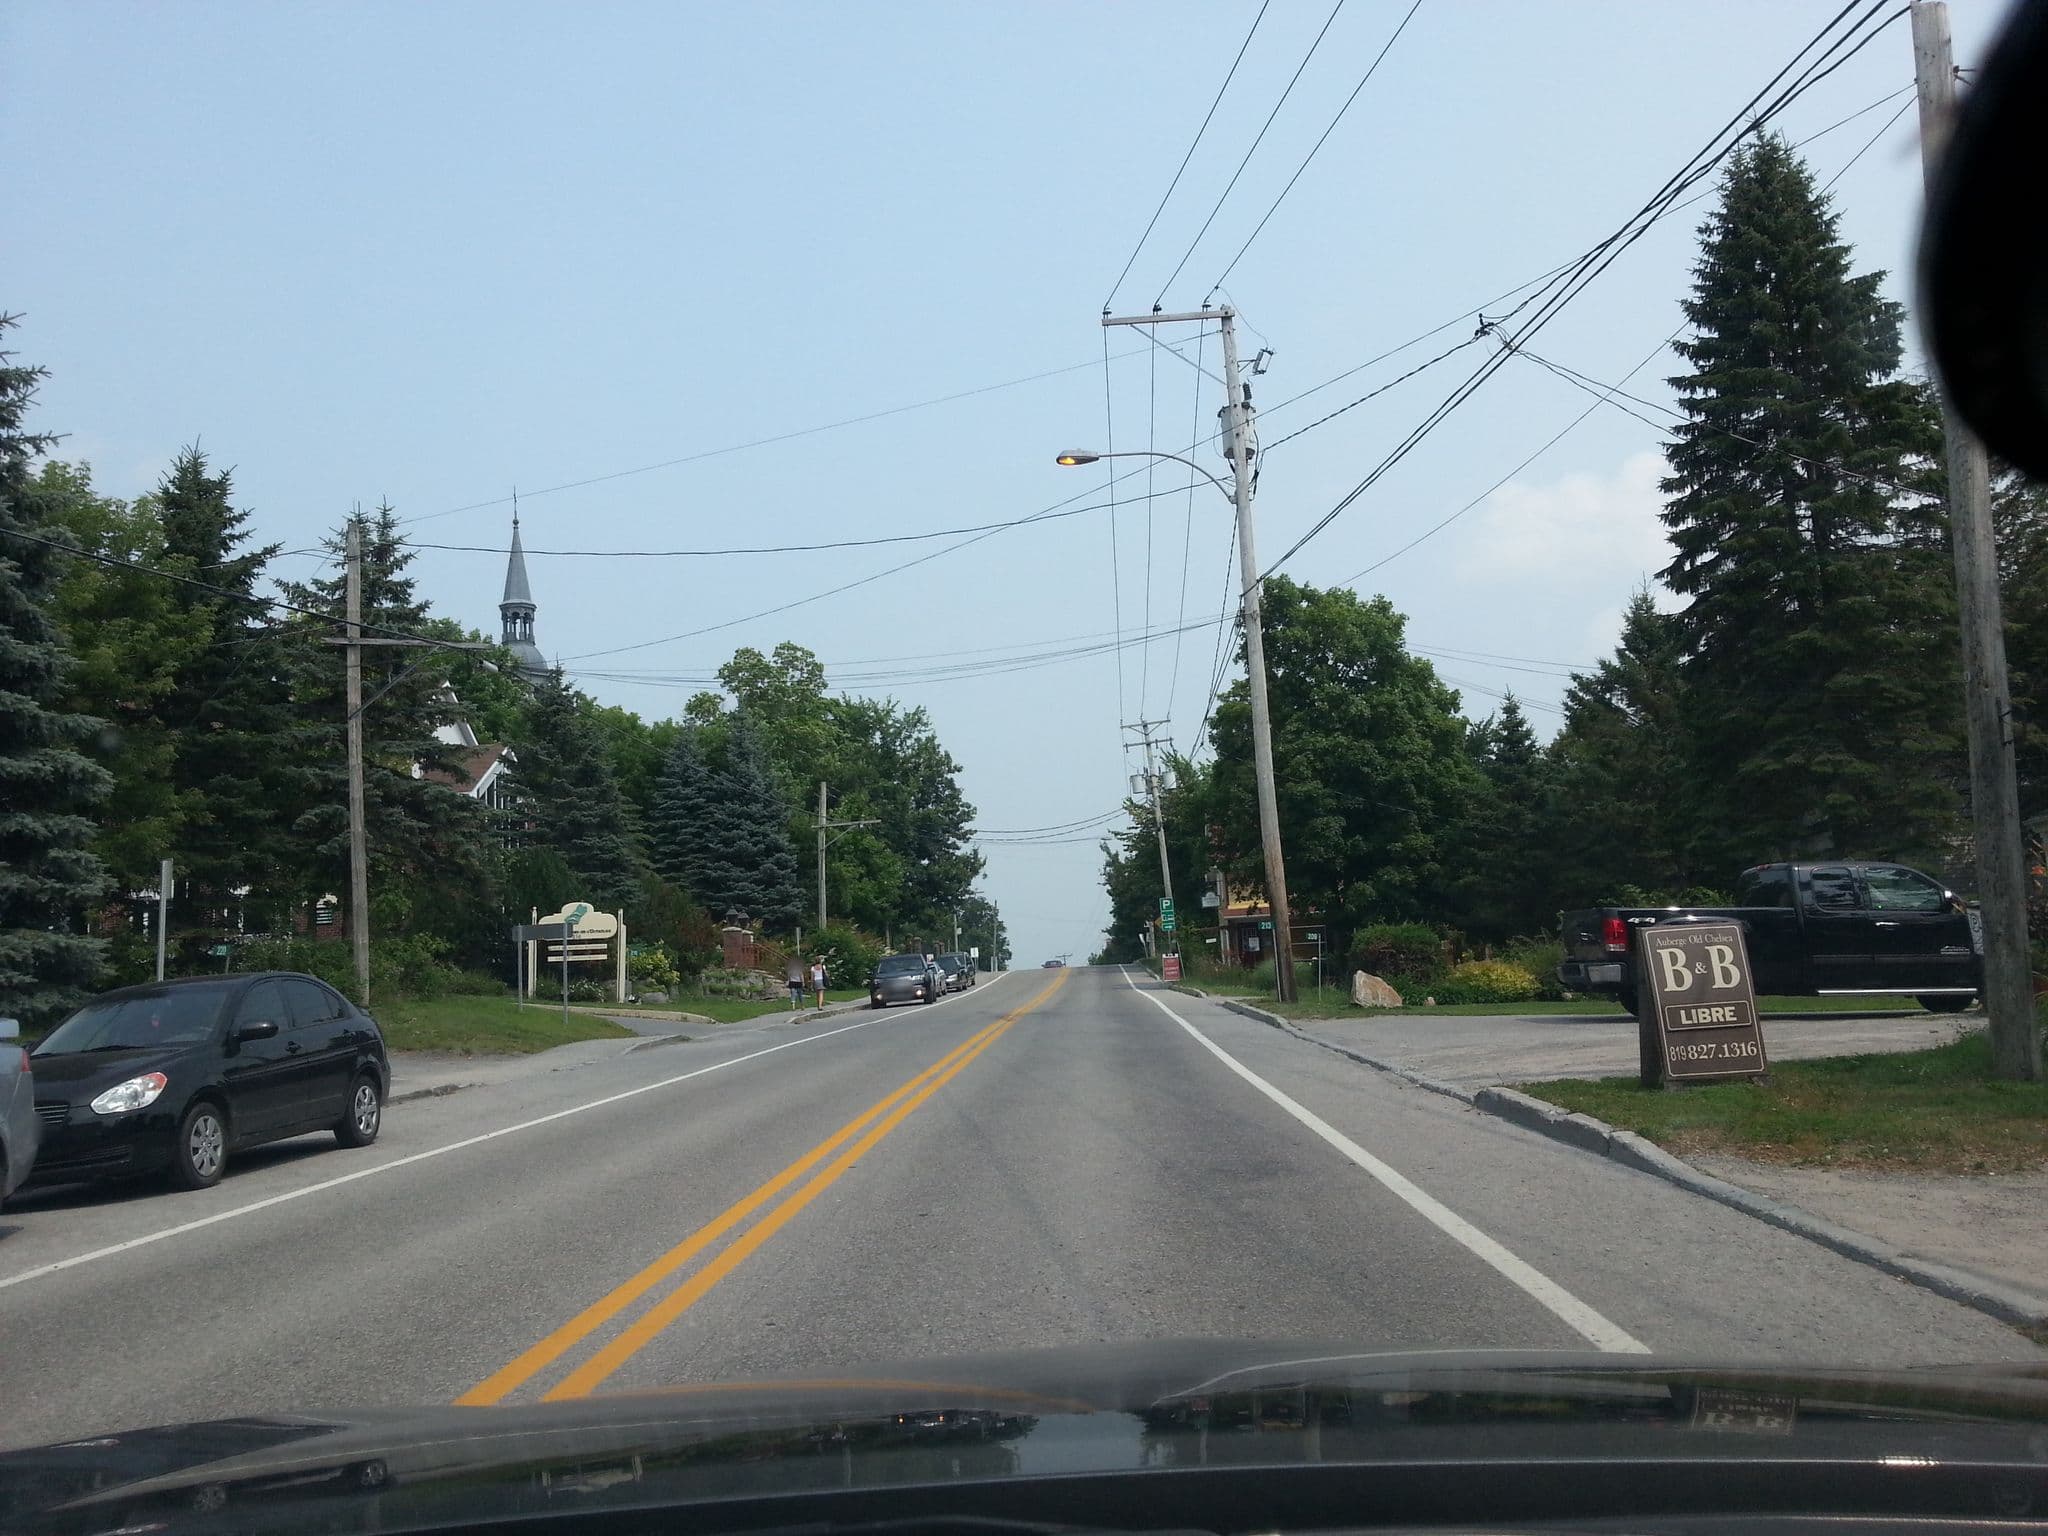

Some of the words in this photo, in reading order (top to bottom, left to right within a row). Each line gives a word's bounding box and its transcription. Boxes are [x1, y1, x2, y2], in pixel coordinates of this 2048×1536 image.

[1162, 899, 1171, 909] P
[1656, 937, 1687, 948] Auberge
[1688, 934, 1703, 944] Old
[1704, 933, 1733, 943] Chelsea
[1680, 1006, 1737, 1024] LIBRE
[1669, 1045, 1687, 1061] 819
[1687, 1041, 1757, 1060] 827.1316
